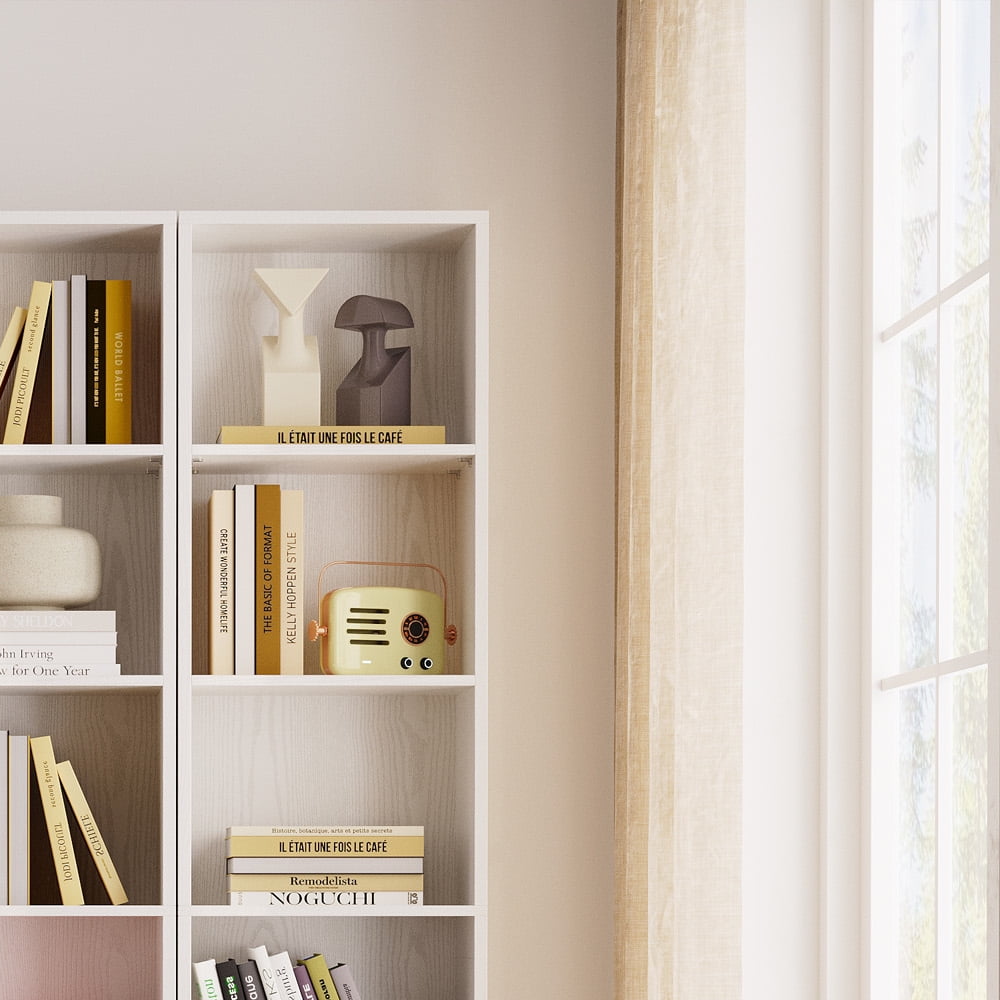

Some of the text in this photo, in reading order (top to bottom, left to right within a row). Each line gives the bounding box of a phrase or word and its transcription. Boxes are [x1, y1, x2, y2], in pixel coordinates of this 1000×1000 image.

[27, 305, 40, 352] second glance
[114, 332, 124, 403] WORLD BALLET
[12, 367, 30, 426] JODI PICOULT
[278, 430, 403, 444] IL ÉTAIT UNE FOIS LE CAFÉ
[219, 528, 228, 634] CREATE WONDERFUL HOMELIFE
[264, 524, 272, 634] THE BASIC OF FORMAT
[286, 532, 296, 644] KELLY HOPPEN STYLE
[13, 615, 73, 627] SHELDON
[20, 648, 54, 661] Irving
[12, 664, 30, 676] for
[32, 665, 60, 676] One
[63, 665, 91, 676] Year
[279, 840, 388, 852] IL ÉTAIT UNE FOIS LE CAFÉ
[290, 876, 358, 886] Remodelista
[269, 892, 376, 905] NOGUCHI
